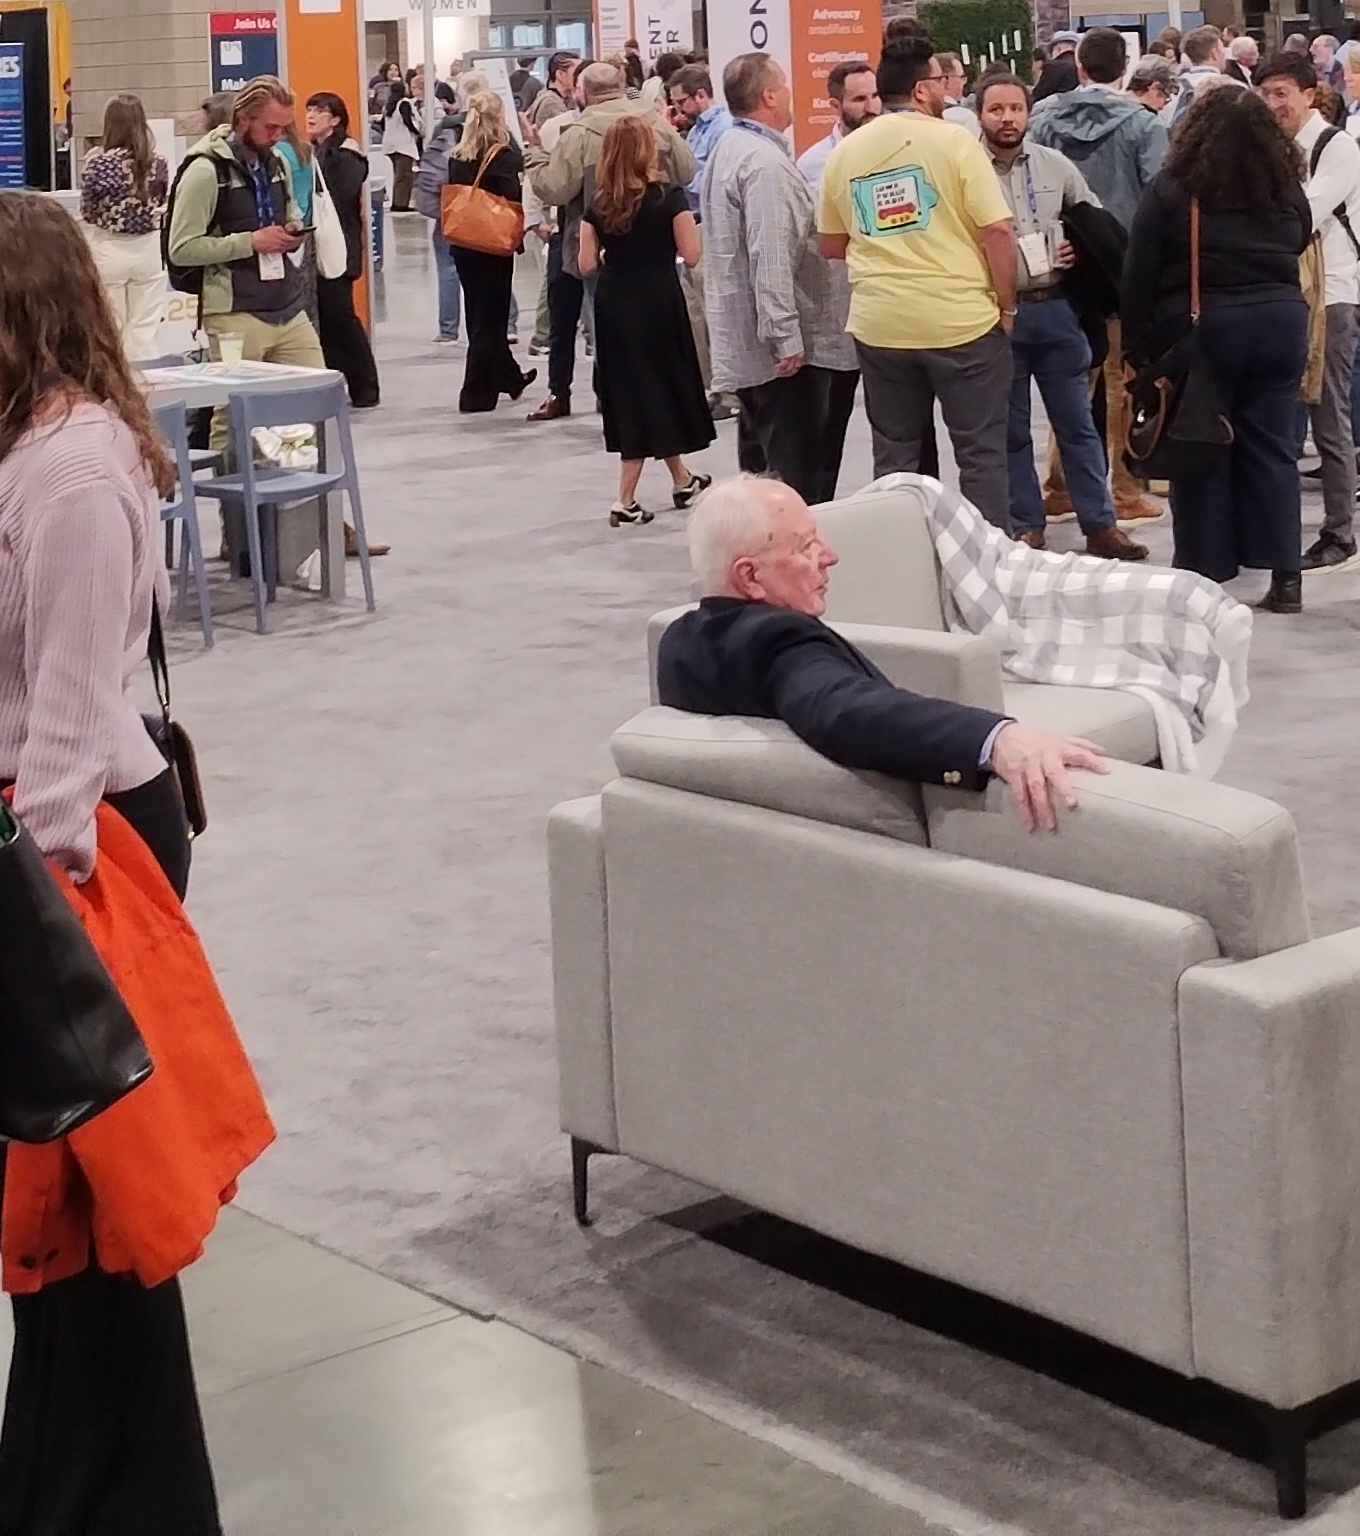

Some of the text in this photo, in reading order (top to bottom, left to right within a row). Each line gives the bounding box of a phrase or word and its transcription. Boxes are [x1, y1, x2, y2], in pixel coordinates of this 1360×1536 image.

[812, 8, 861, 21] Advocacy
[234, 18, 257, 30] Join
[258, 18, 272, 29] Us
